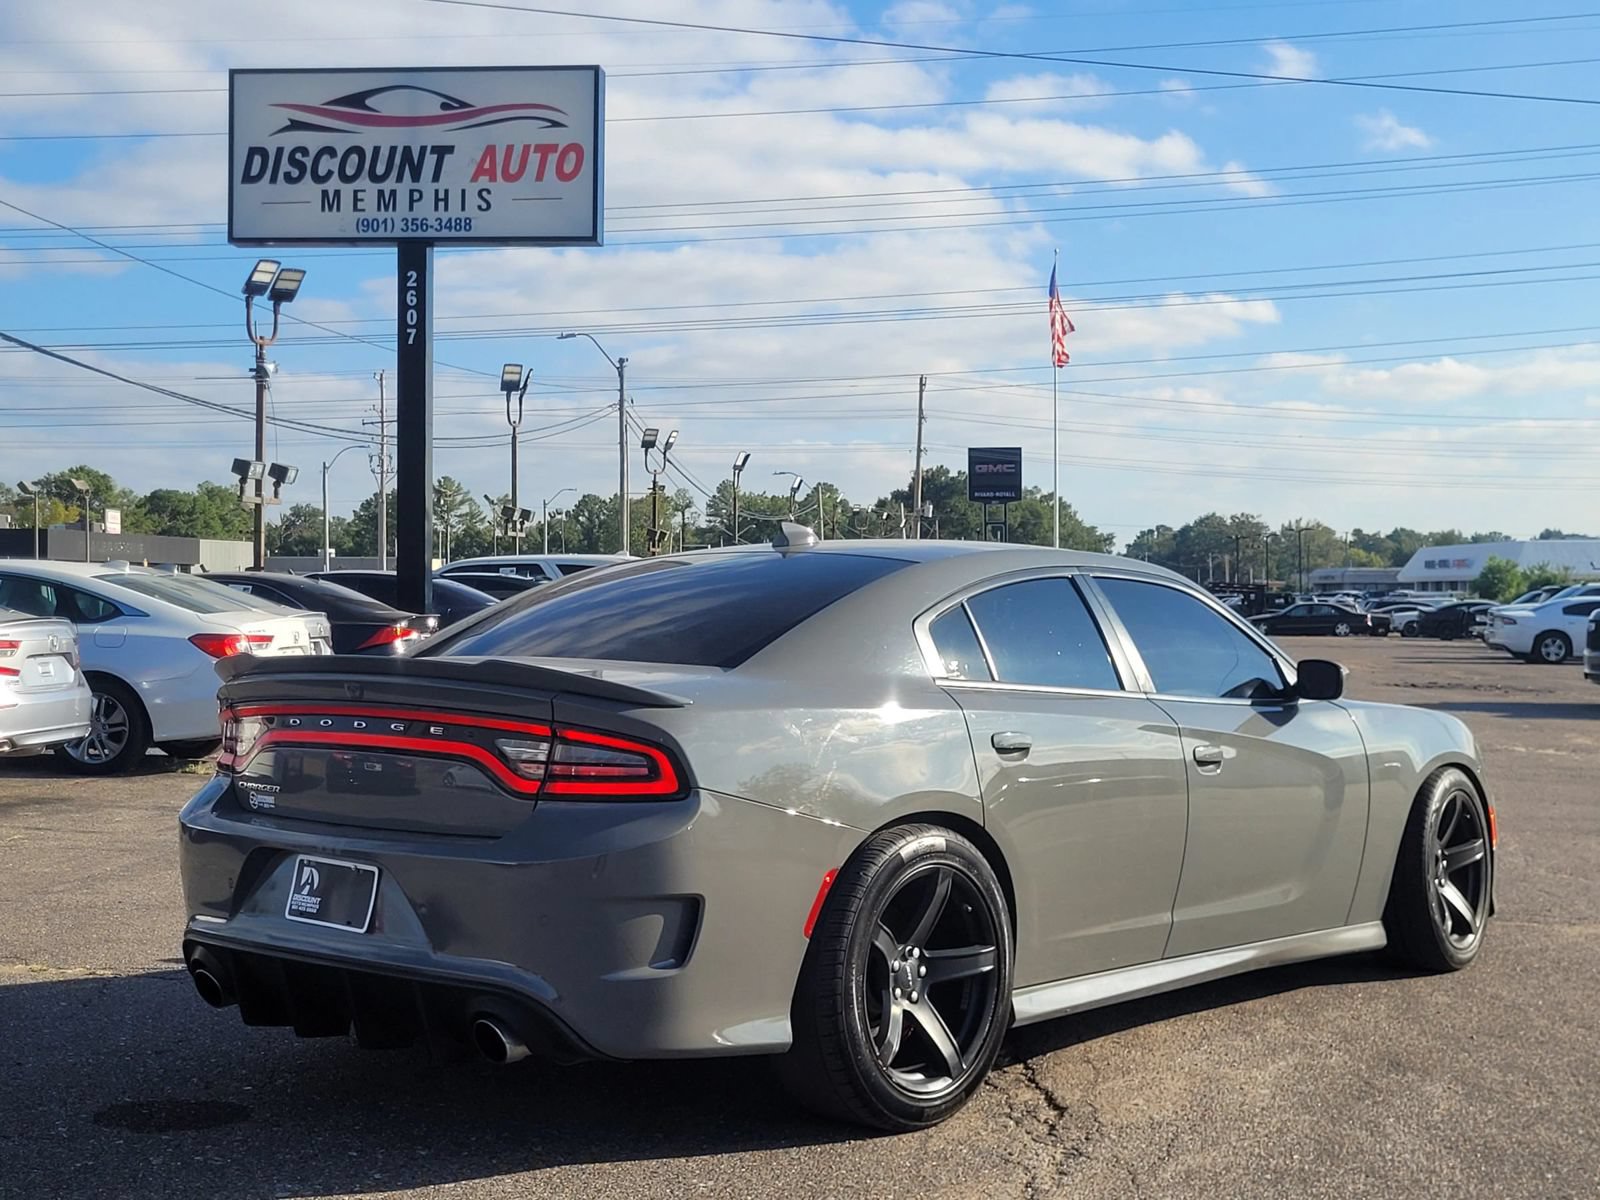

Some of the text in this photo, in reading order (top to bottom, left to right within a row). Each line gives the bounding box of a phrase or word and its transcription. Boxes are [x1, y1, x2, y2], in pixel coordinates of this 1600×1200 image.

[240, 142, 585, 185] DISCOUNT AUTO
[320, 187, 492, 213] MEMPHIS
[355, 216, 473, 233] (901) 356-3488
[406, 270, 418, 345] 2607
[975, 464, 1016, 473] GMC
[289, 718, 444, 735] DODGE
[238, 781, 281, 793] CHARGER
